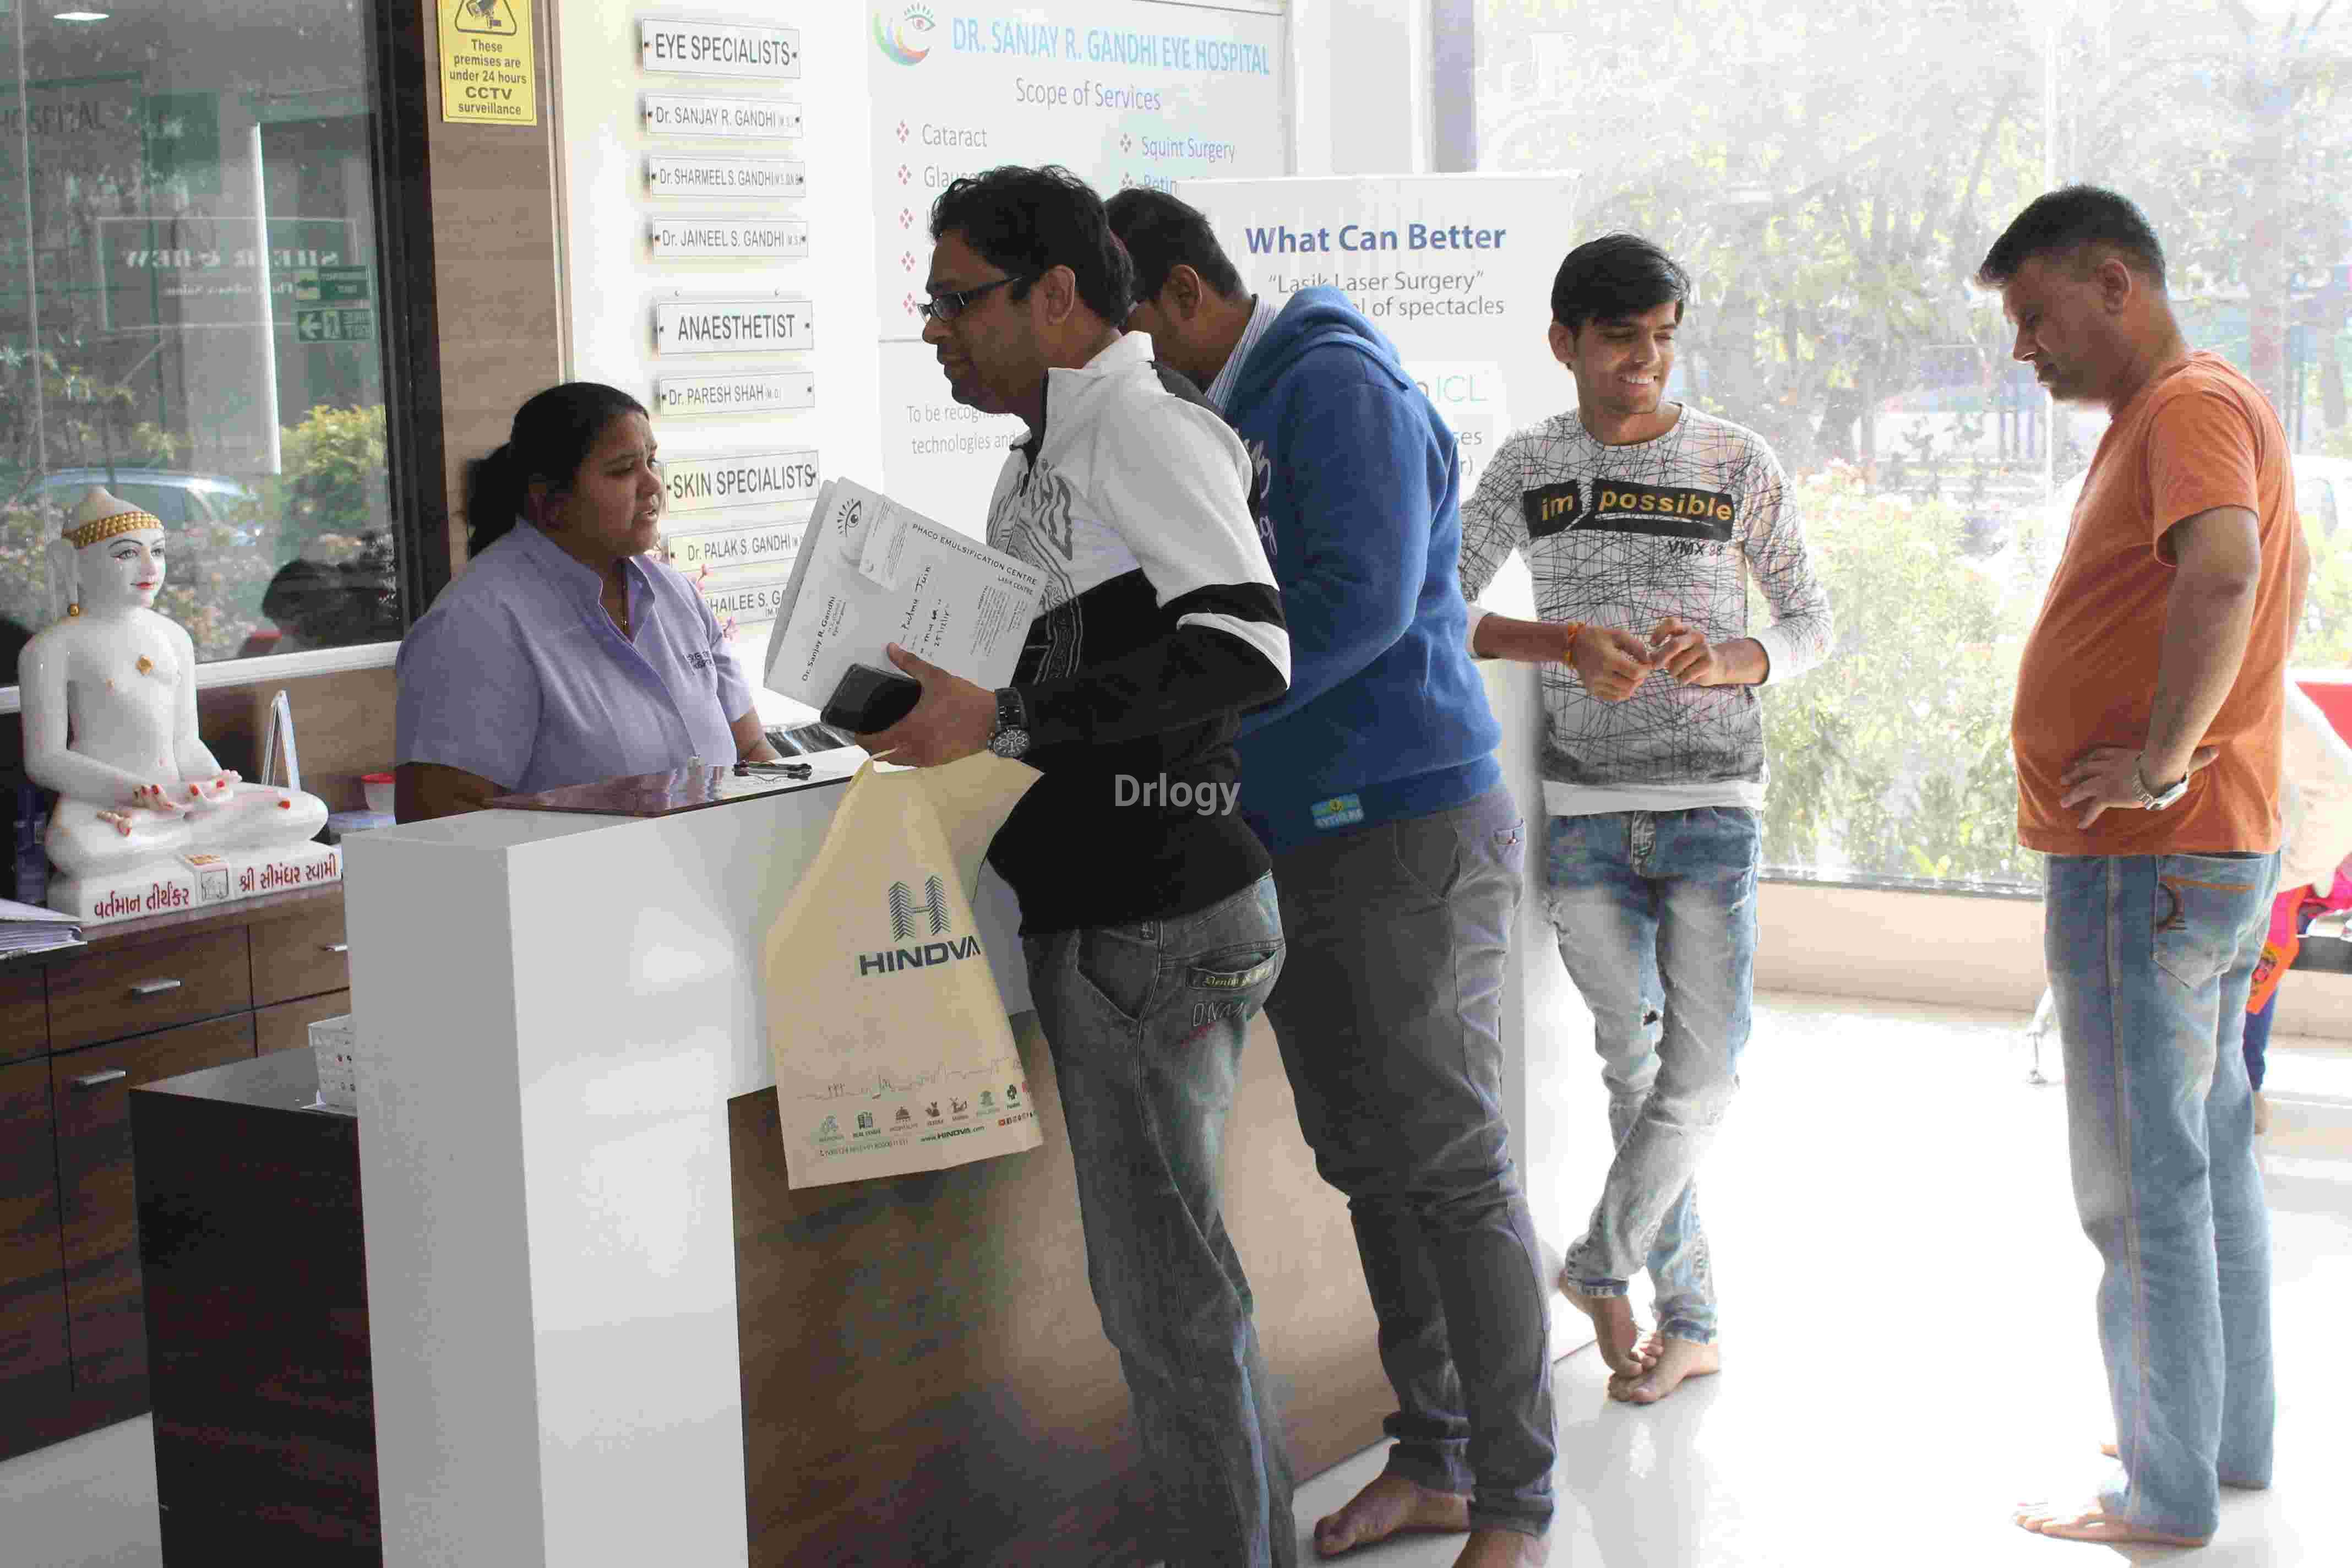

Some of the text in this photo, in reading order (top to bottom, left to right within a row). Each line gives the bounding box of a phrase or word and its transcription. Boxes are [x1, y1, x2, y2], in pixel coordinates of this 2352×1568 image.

[471, 39, 503, 53] These
[656, 33, 790, 66] EYE SPECIALISTS
[952, 17, 1270, 75] DR. SANJAY R. GANDHI EYE HOSPITAL
[454, 54, 521, 68] premises are
[449, 70, 527, 84] under 24 hours
[465, 86, 513, 100] CCTV
[1016, 78, 1161, 110] Scope of Services
[458, 102, 521, 115] surveillance
[656, 106, 671, 124] Dr.
[674, 107, 718, 126] SANJAY
[722, 109, 732, 126] R.
[736, 110, 776, 128] GANDHI
[922, 123, 987, 148] Cataract
[1142, 137, 1235, 163] Squint Surgery
[660, 168, 673, 184] Dr.
[738, 170, 774, 186] GANDHI
[924, 165, 978, 188] Glau
[1144, 174, 1180, 194] Retin
[662, 230, 677, 247] Dr.
[681, 230, 727, 247] JAINEEL
[731, 231, 740, 247] S.
[744, 231, 784, 247] GANDHI
[1245, 223, 1506, 254] What Can Better
[1372, 297, 1393, 316] of
[1399, 295, 1505, 321] spectacles
[678, 313, 795, 341] ANAESTHETIST
[669, 389, 684, 405] Dr.
[687, 385, 732, 405] PARESH
[735, 384, 764, 402] SHAH
[907, 403, 1010, 423] To be recog
[912, 431, 1016, 455] technologies and
[673, 464, 814, 499] SKIN SPECIALISTS
[1599, 488, 1732, 521] possible
[688, 545, 701, 561] Dr.
[705, 542, 738, 560] PALAK
[741, 539, 749, 556] S.
[752, 532, 790, 553] GANDHI
[940, 537, 1005, 570] EMULSIFICATION
[1006, 567, 1038, 585] CENTRE
[758, 593, 769, 608] S.
[808, 640, 822, 667] Sanjay
[821, 596, 836, 627] Gandhi
[859, 935, 981, 976] HINDVA
